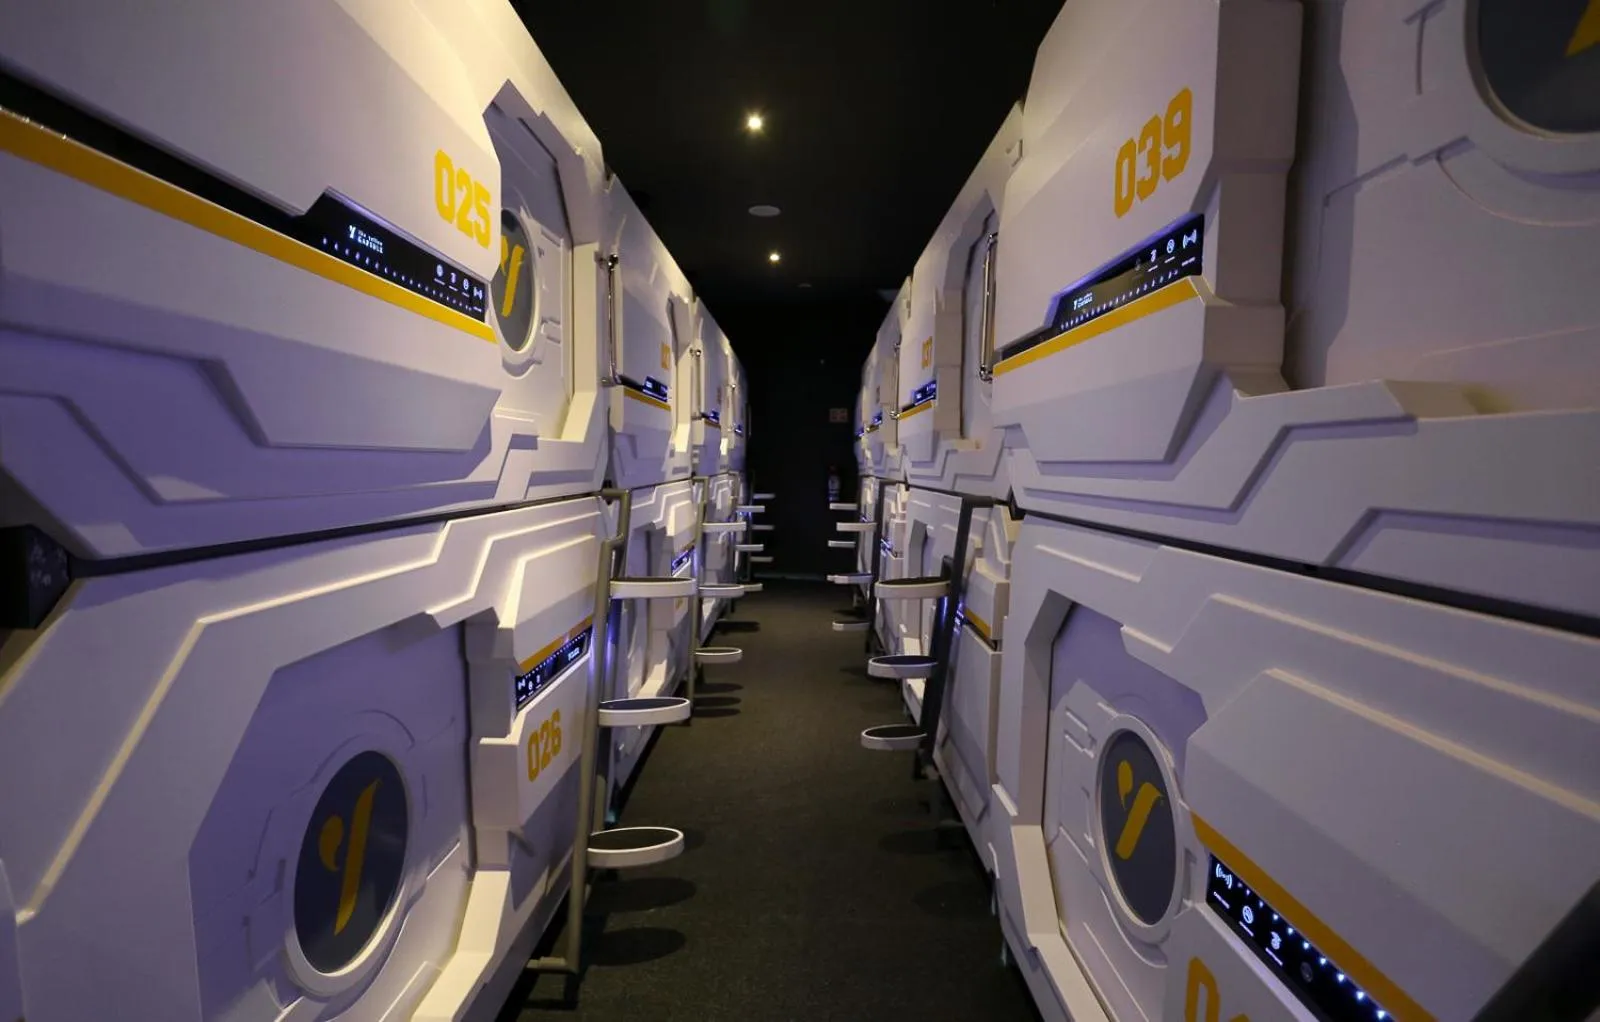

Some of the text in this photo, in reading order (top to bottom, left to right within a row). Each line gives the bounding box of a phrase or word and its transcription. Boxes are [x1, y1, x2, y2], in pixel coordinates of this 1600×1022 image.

[434, 149, 491, 249] 025
[1114, 86, 1193, 219] 039
[527, 708, 562, 782] 026
